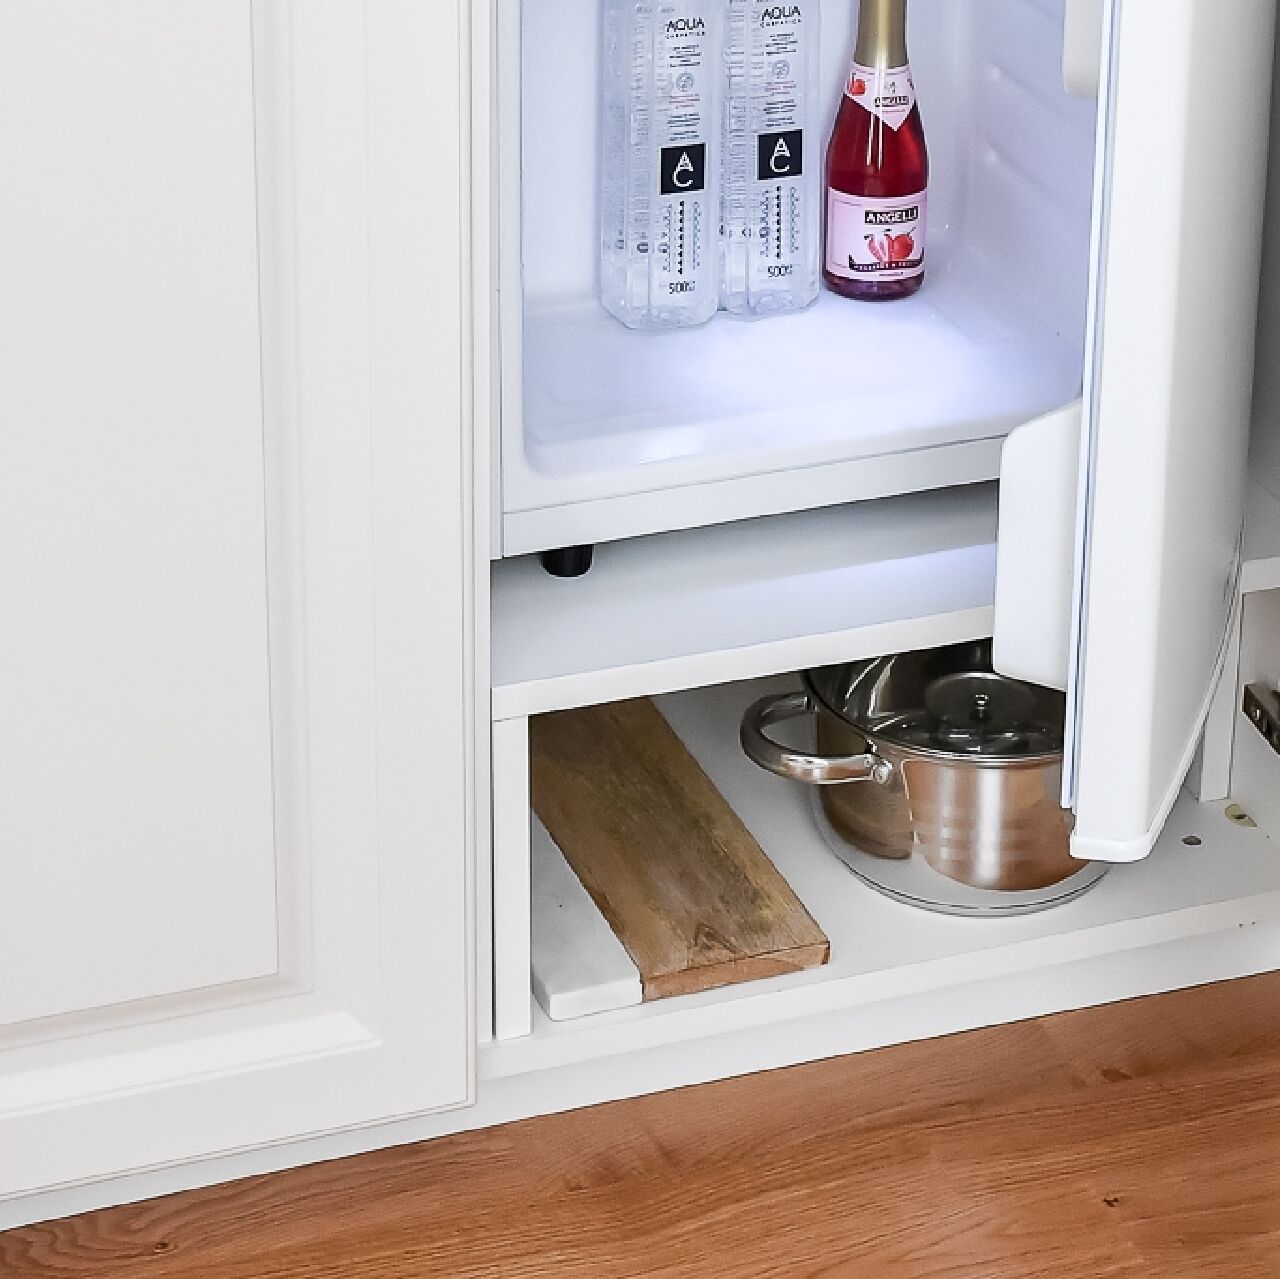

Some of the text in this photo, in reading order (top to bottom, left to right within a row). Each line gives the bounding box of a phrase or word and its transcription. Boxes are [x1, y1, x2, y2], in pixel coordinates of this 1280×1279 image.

[761, 5, 801, 21] AQUA
[665, 16, 705, 32] AQUA
[866, 207, 918, 222] ANGELLI
